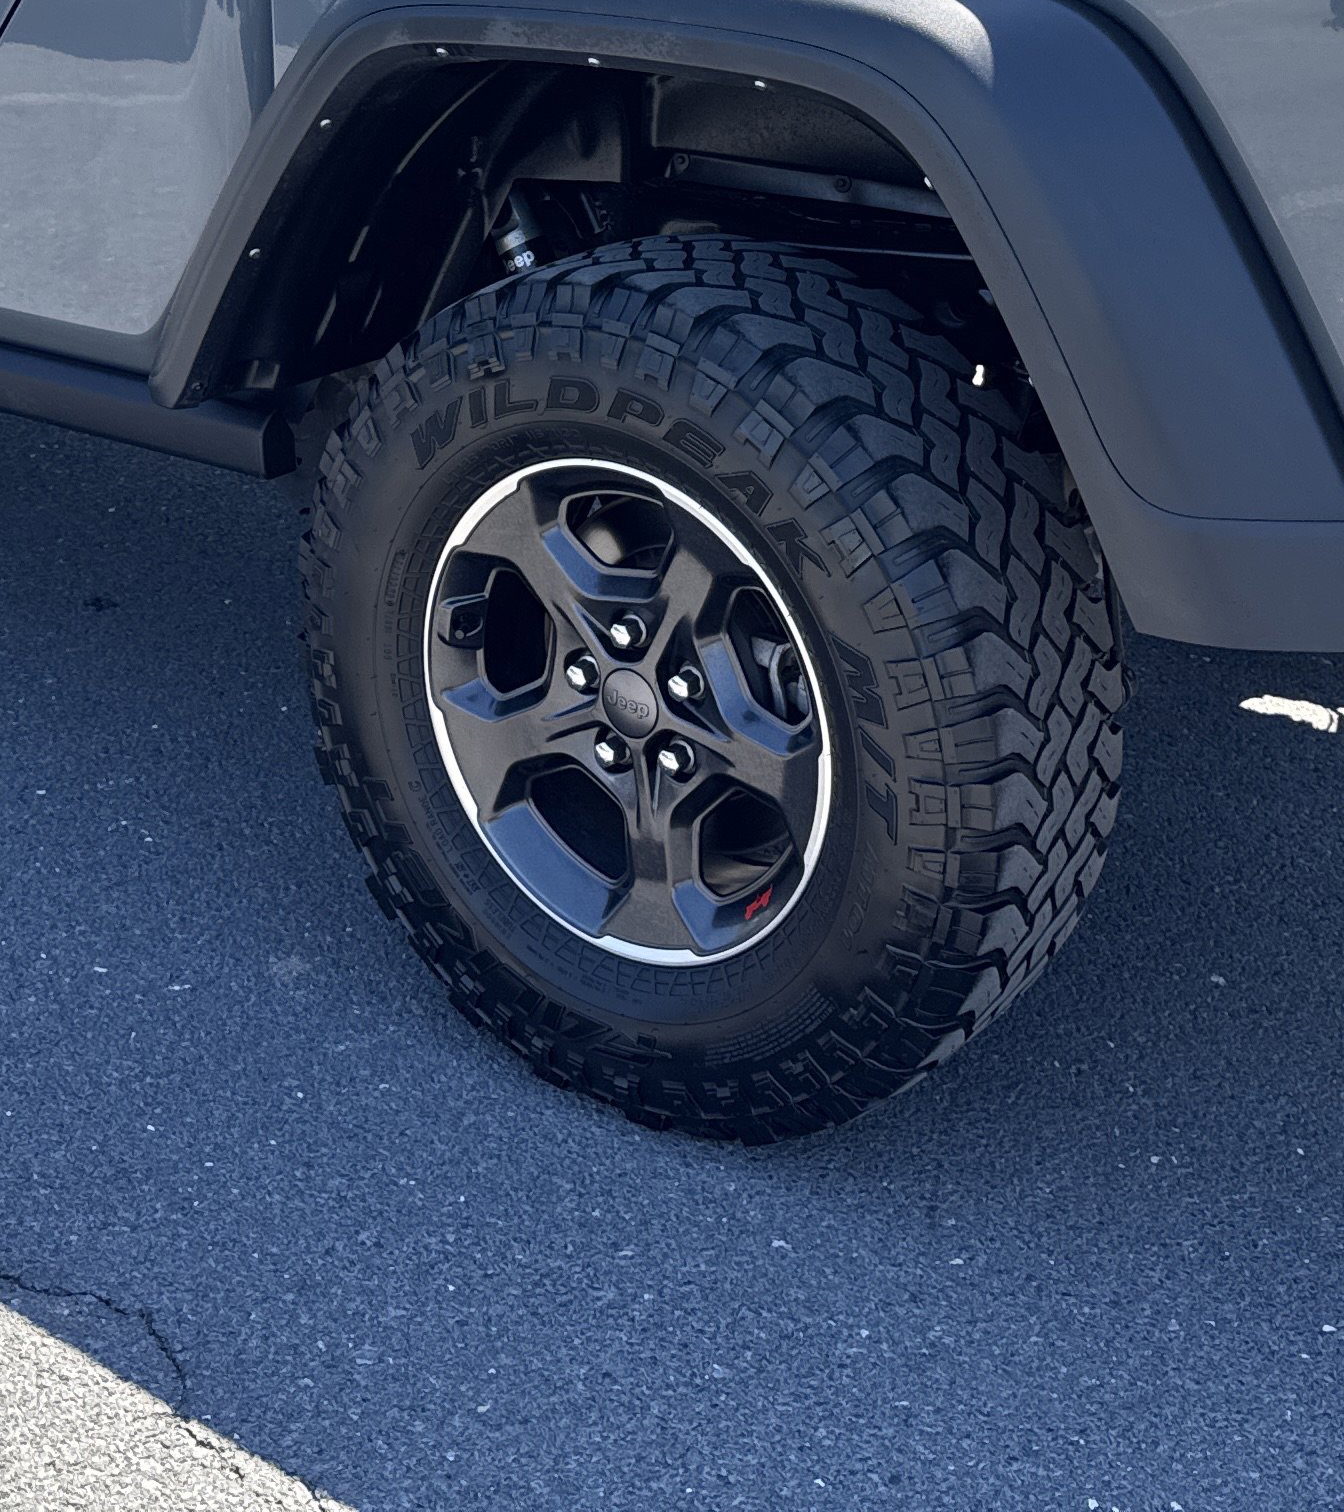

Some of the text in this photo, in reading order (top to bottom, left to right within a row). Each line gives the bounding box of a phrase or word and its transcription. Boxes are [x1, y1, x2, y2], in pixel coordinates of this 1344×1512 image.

[504, 250, 535, 272] eep
[409, 376, 832, 578] WILDPEAK
[606, 689, 650, 720] Jeep
